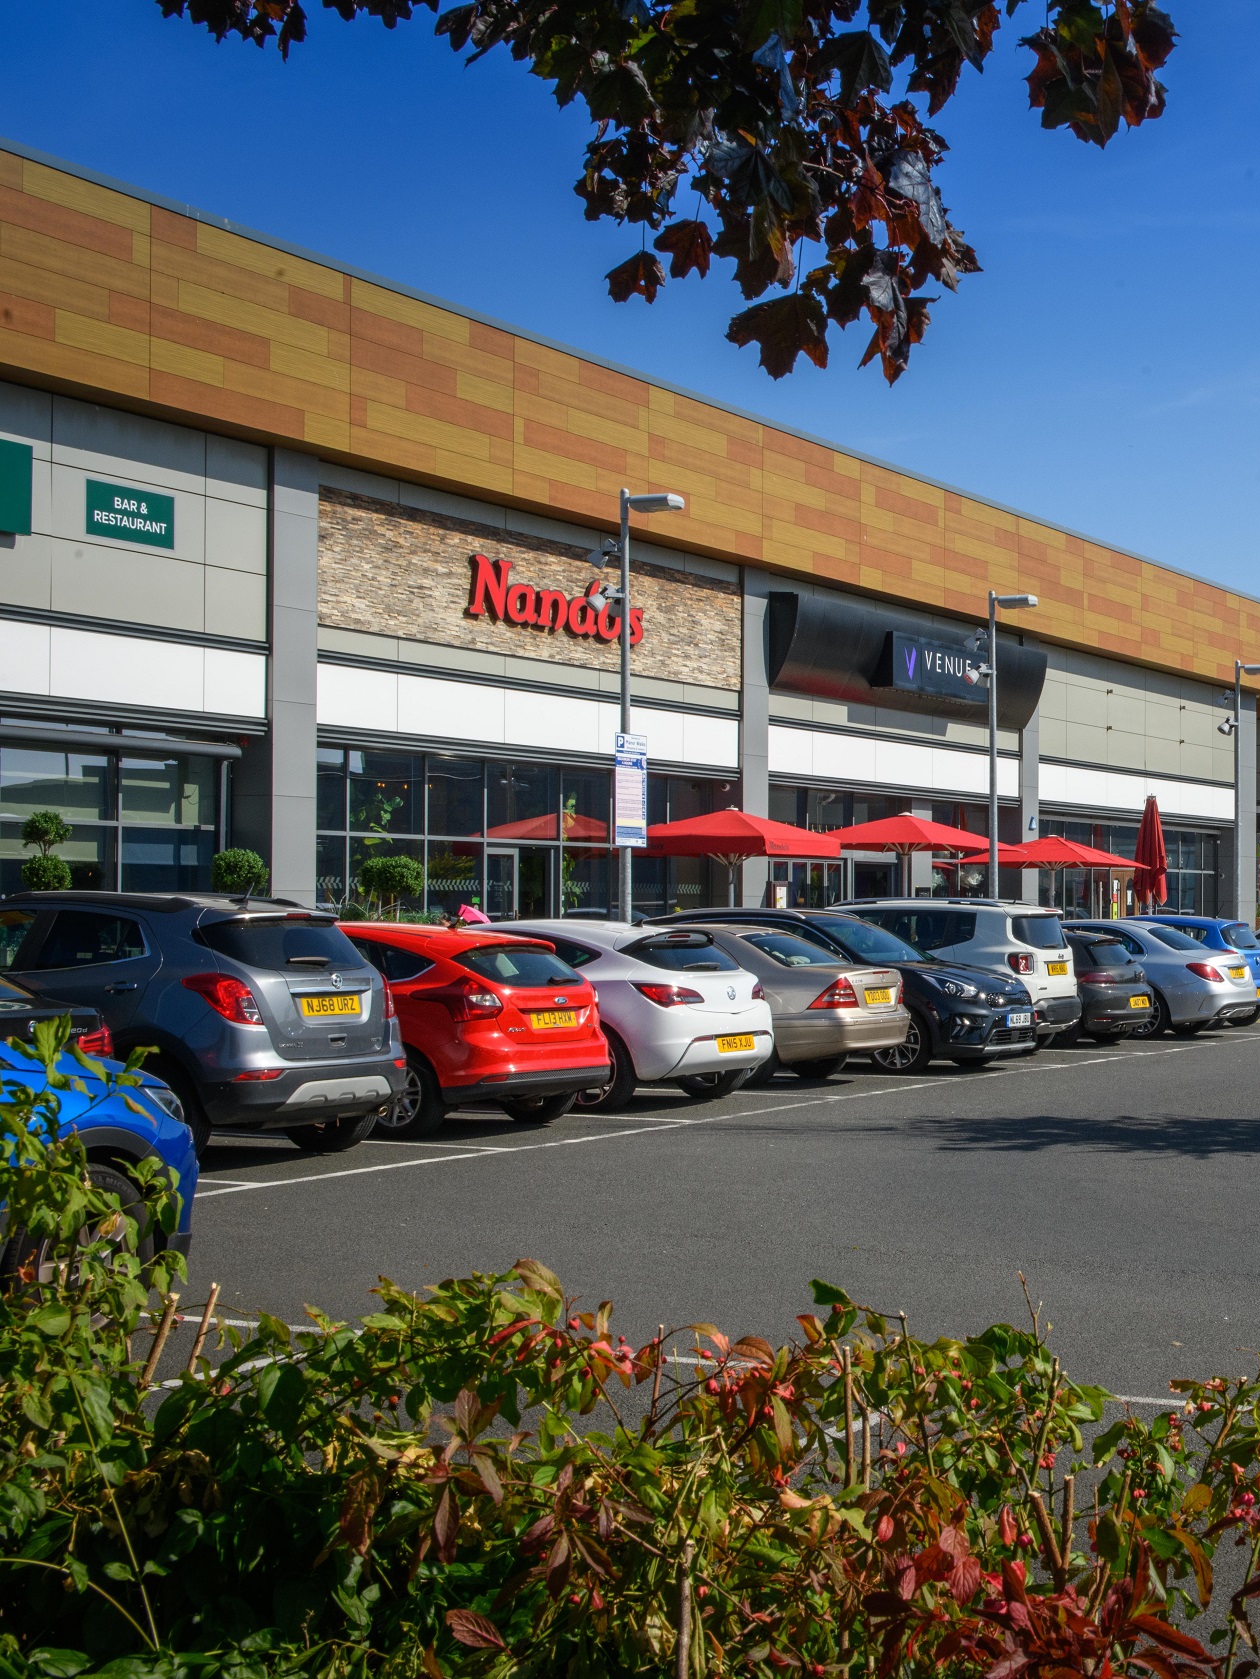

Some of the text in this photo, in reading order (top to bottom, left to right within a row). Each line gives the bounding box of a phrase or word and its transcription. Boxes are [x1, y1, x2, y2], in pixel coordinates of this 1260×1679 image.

[114, 496, 148, 514] BAR &
[94, 509, 167, 535] RESTAURANT
[469, 554, 644, 645] Nandos
[925, 650, 972, 677] VENUE
[306, 997, 356, 1013] NJ68 URZ
[536, 1011, 557, 1025] FL13
[721, 1036, 752, 1050] FN15 XJU
